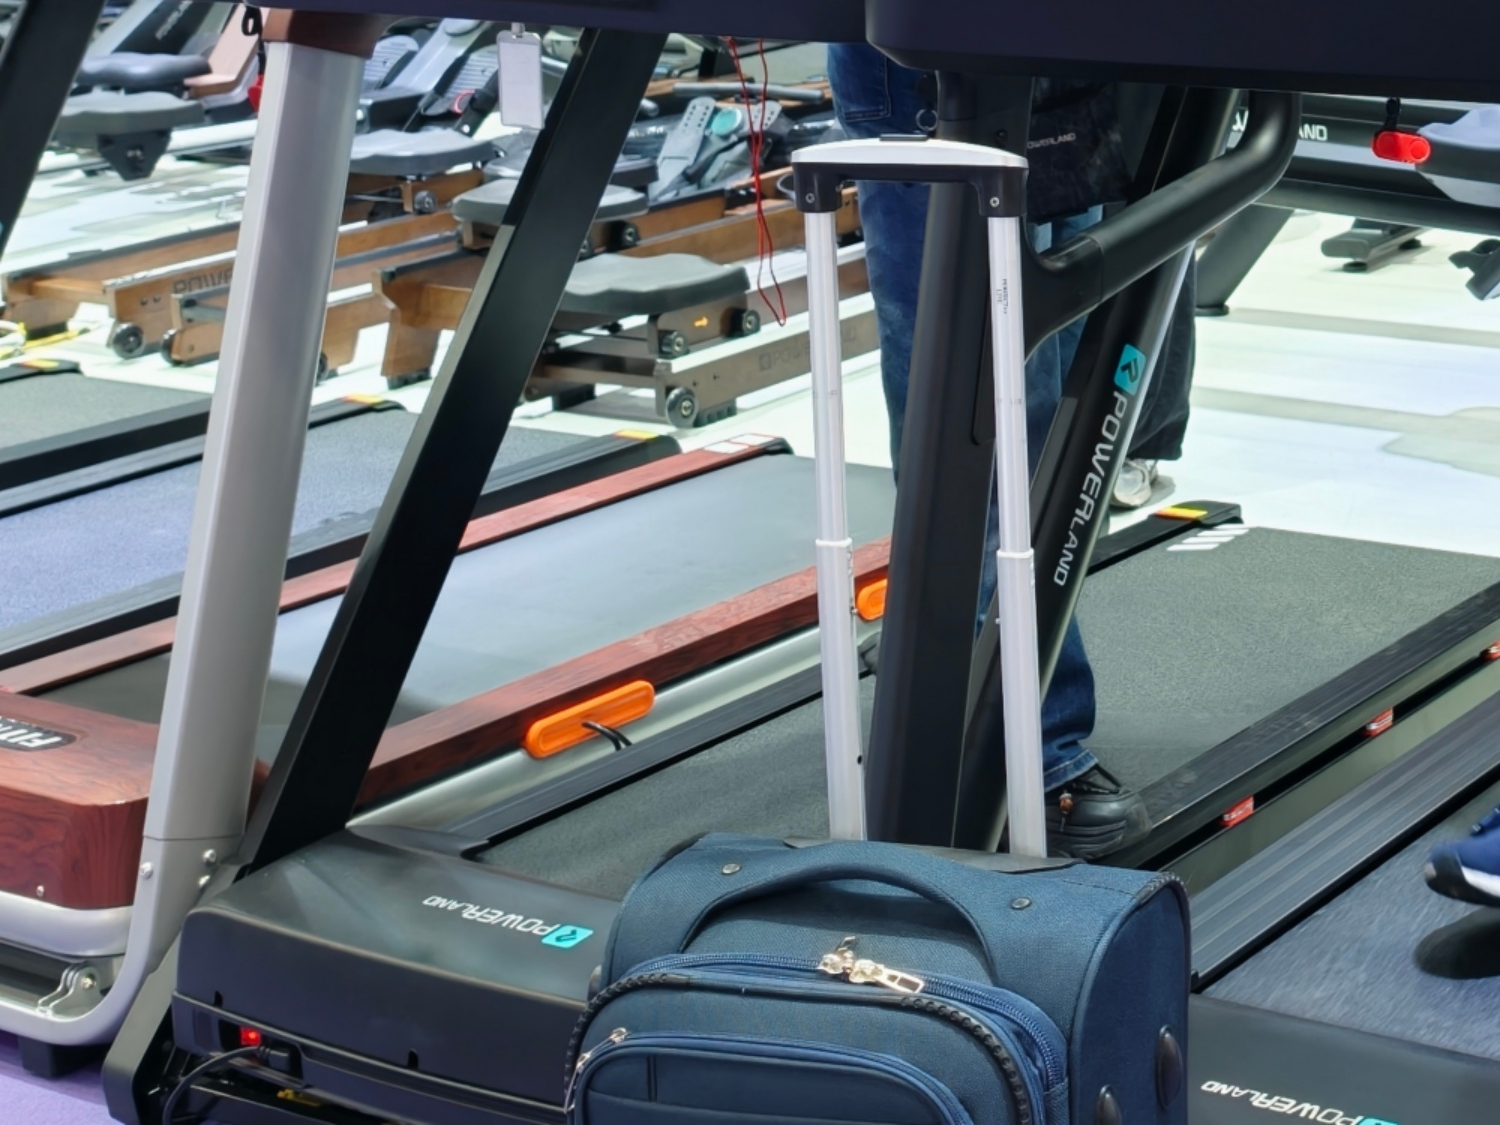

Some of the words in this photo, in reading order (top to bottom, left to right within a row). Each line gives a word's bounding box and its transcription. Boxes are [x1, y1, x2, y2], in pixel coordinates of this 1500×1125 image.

[1053, 390, 1128, 587] POWERLAND
[422, 895, 561, 936] POWERLAND
[1200, 1080, 1365, 1125] POWERLAND
